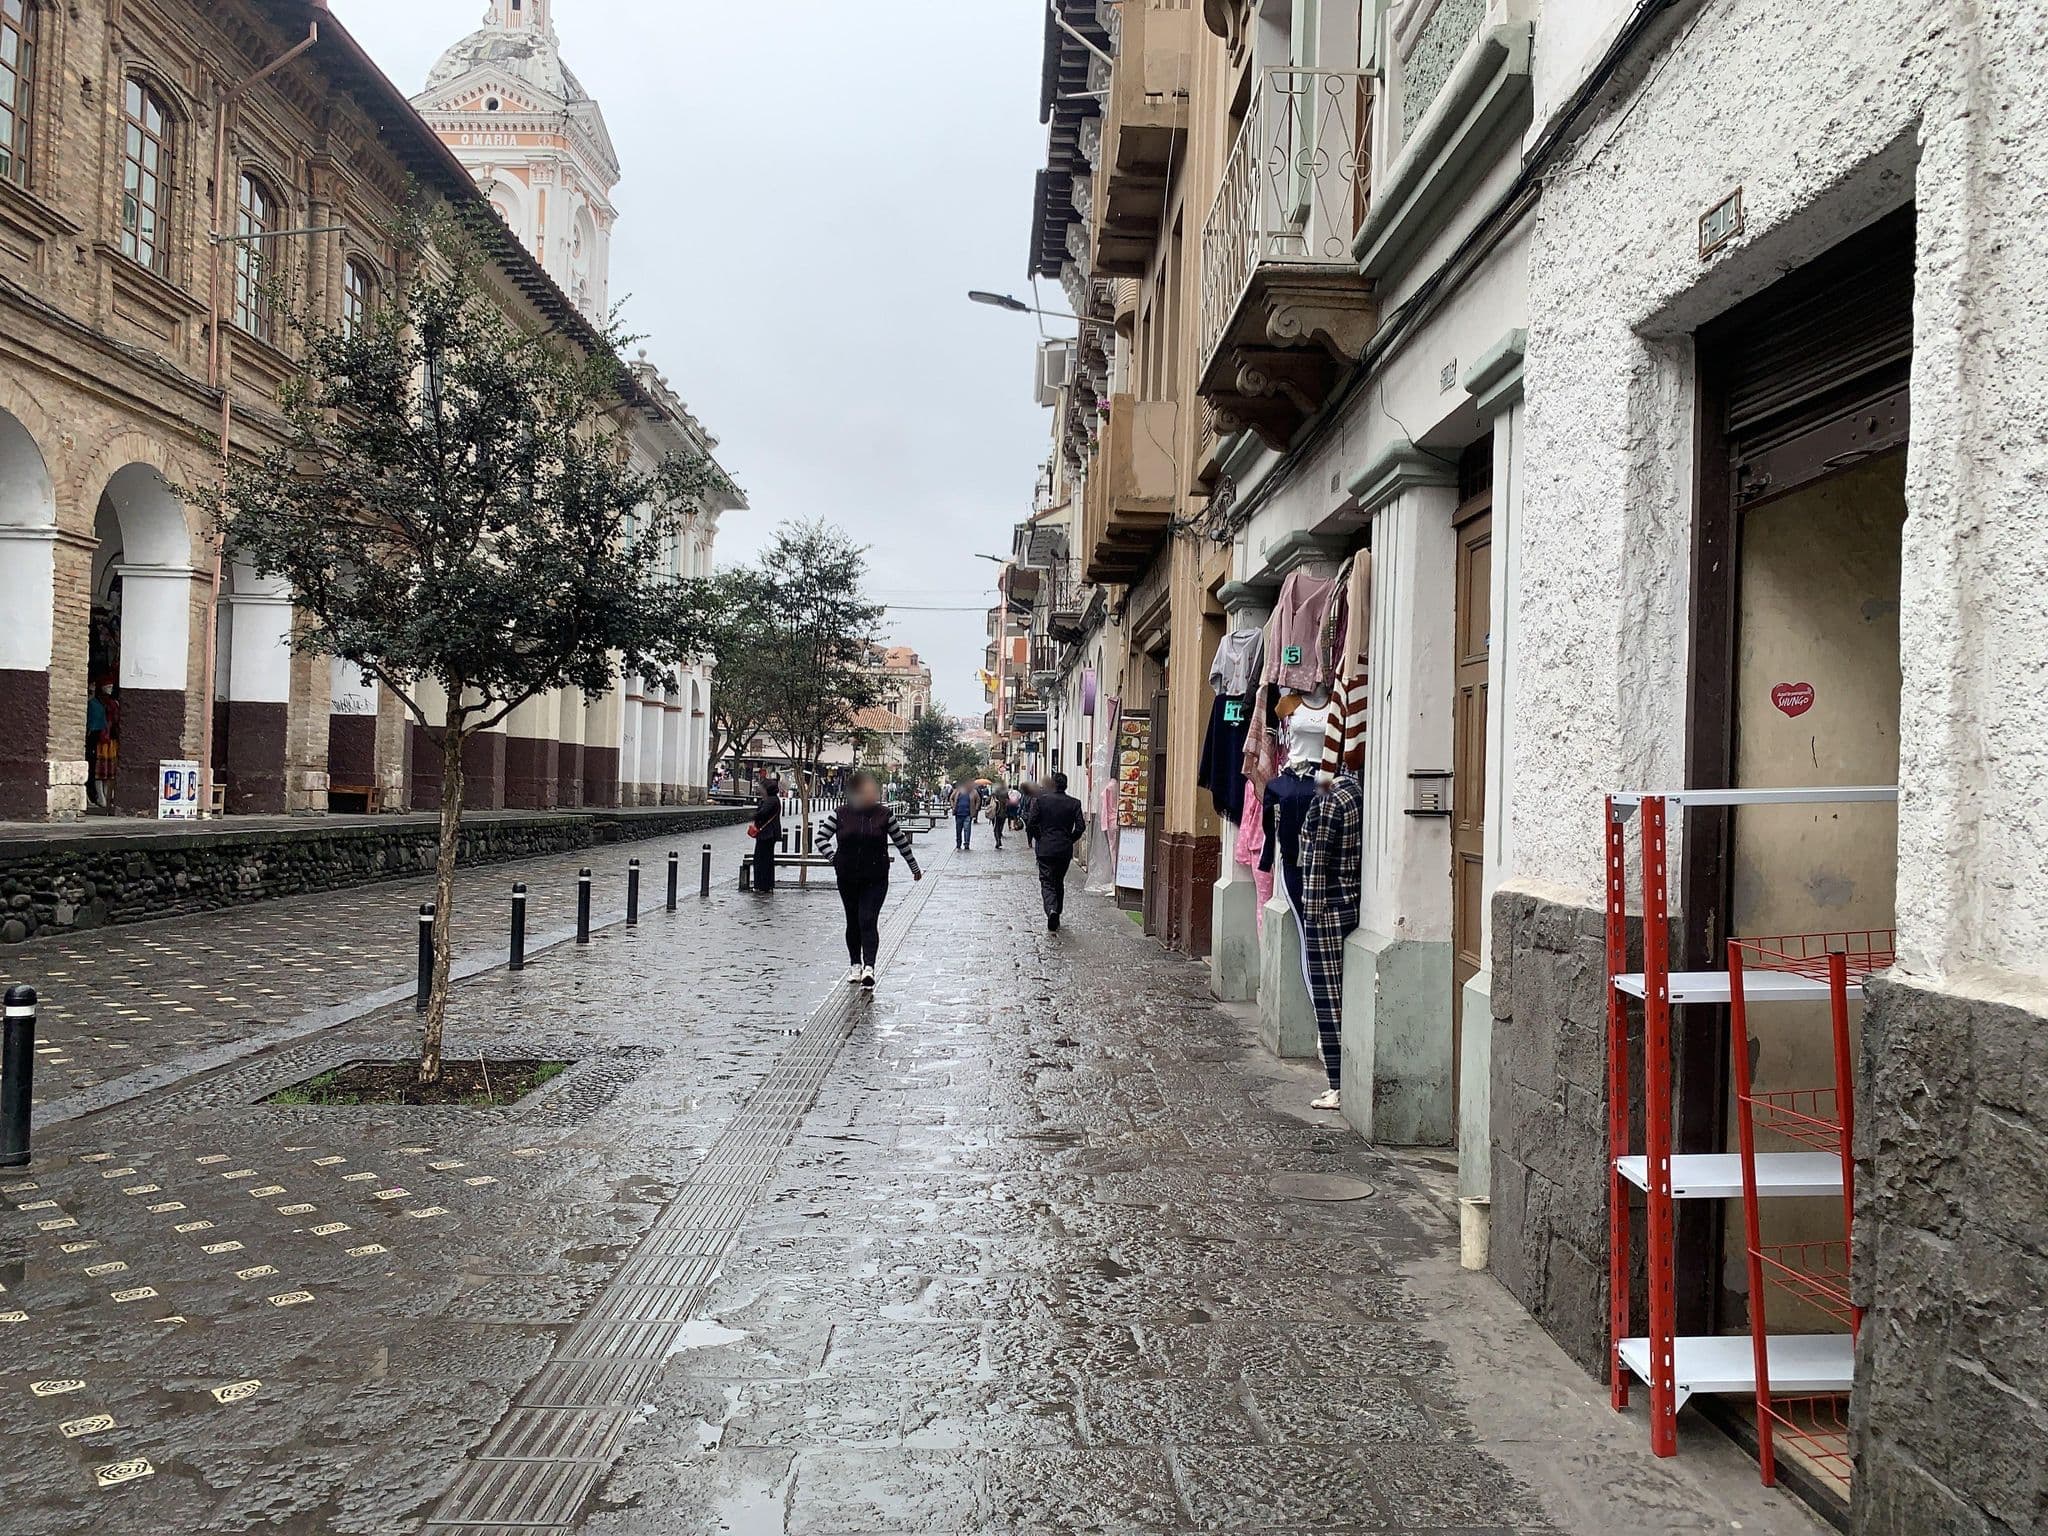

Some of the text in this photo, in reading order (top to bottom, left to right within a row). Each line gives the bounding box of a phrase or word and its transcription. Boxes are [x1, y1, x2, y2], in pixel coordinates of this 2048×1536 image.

[461, 134, 517, 146] O MARIA
[1778, 695, 1809, 707] SHUNGO
